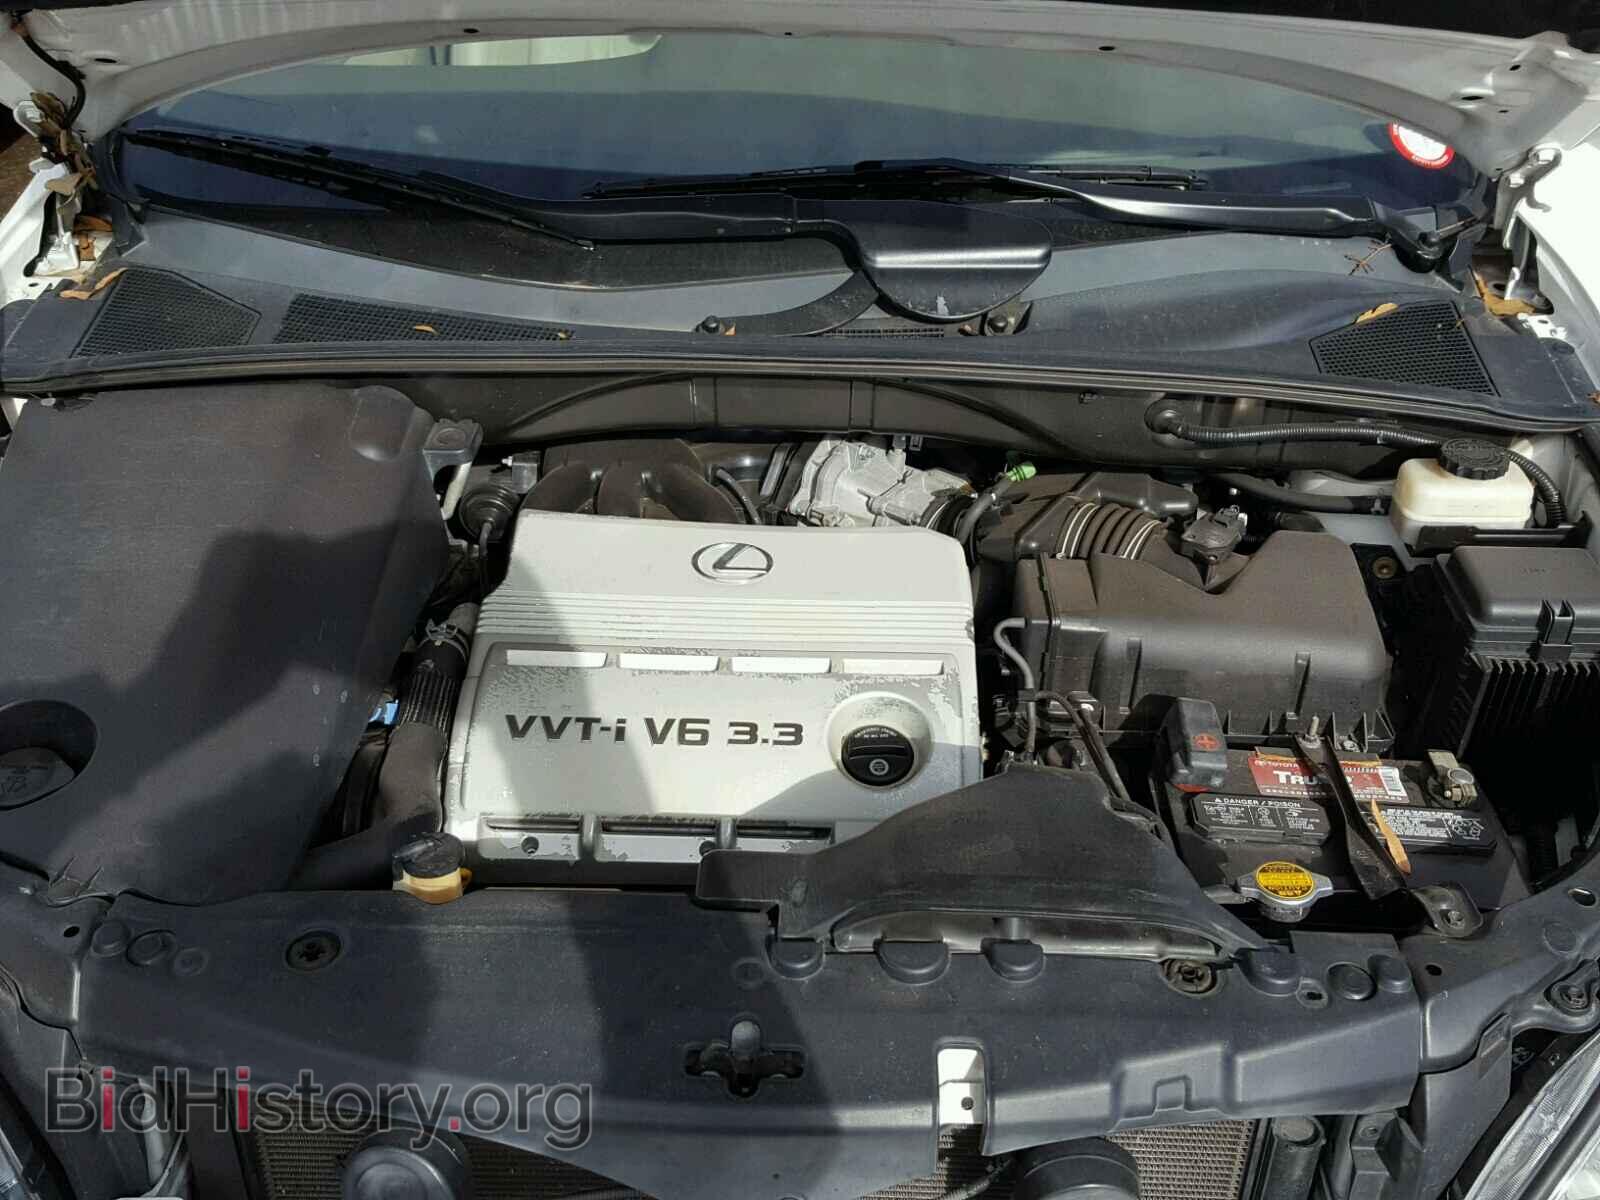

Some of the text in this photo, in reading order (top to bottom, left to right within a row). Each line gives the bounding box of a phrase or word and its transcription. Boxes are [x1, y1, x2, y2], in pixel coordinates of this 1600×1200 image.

[505, 714, 804, 746] VVT-i V6 3.3
[1223, 797, 1259, 806] DANGER
[1267, 800, 1301, 808] POISON
